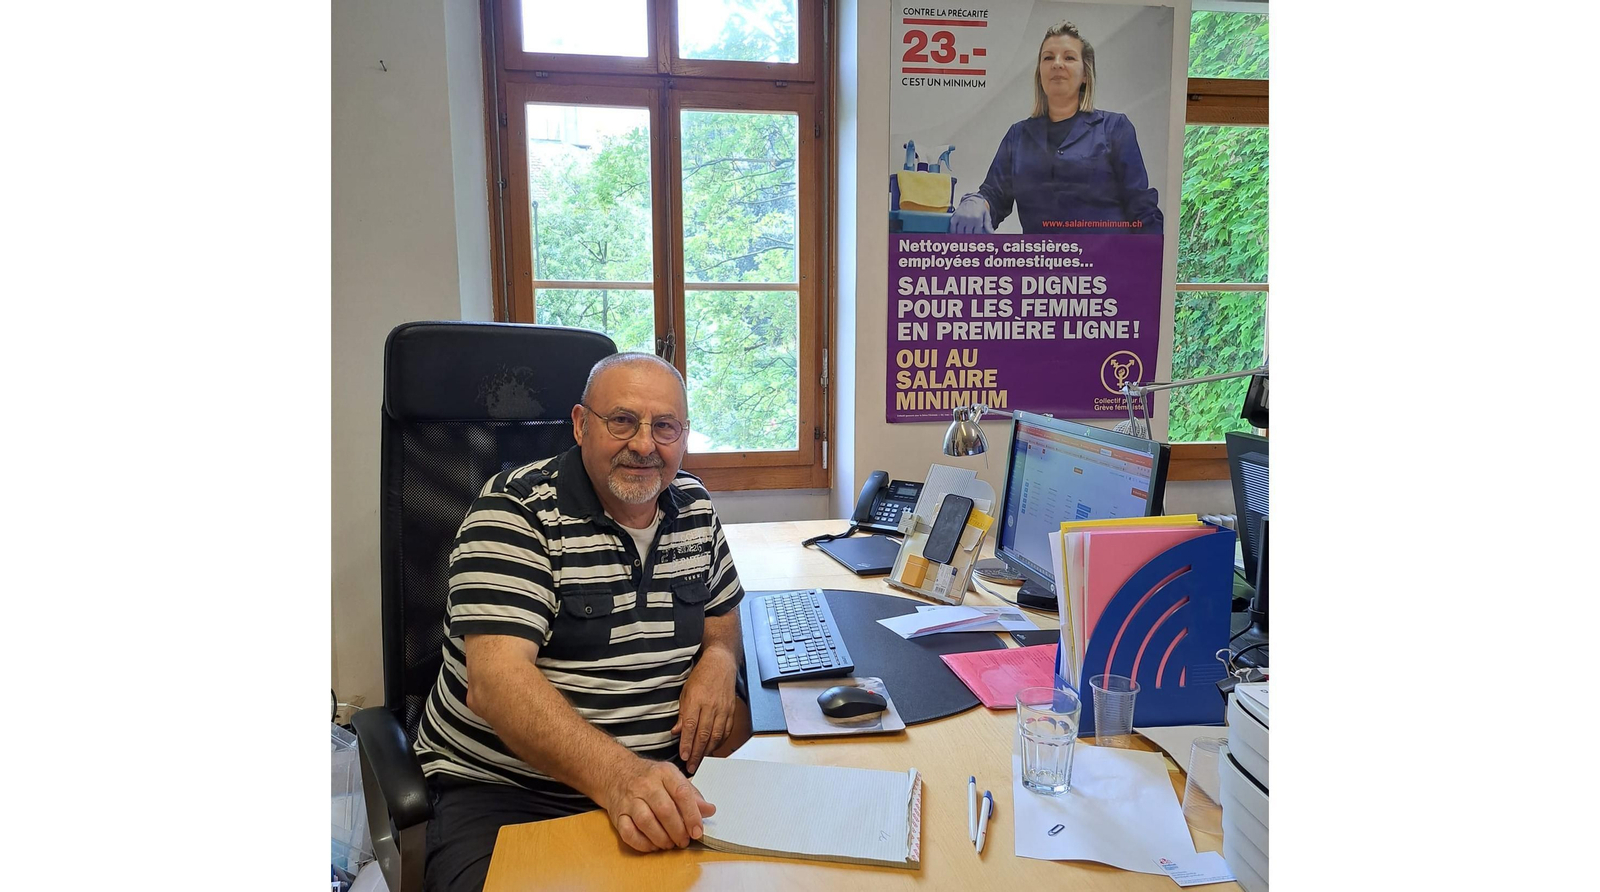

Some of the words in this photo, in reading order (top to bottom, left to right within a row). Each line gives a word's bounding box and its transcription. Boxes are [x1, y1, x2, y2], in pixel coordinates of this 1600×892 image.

[903, 7, 936, 17] CONTRE
[937, 9, 947, 17] LA
[948, 8, 988, 18] PRÉCARITÉ
[927, 78, 942, 87] UN
[943, 78, 986, 88] MINIMUM
[1042, 219, 1142, 228] www.salaireminimum.ch
[899, 239, 999, 255] Nettoyeuses,
[1002, 239, 1083, 255] caissières,
[898, 254, 980, 270] employées
[898, 276, 1014, 296] SALAIRES
[1021, 276, 1107, 295] DIGNES
[898, 299, 963, 318] POUR
[970, 298, 1014, 318] LES
[1021, 298, 1118, 317] FEMMES
[898, 322, 928, 341] EN
[936, 316, 1056, 340] PREMIÈRE
[896, 349, 938, 368] OUI
[945, 348, 978, 368] AU
[896, 369, 998, 389] SALAIRE
[896, 390, 1008, 410] MINIMUM
